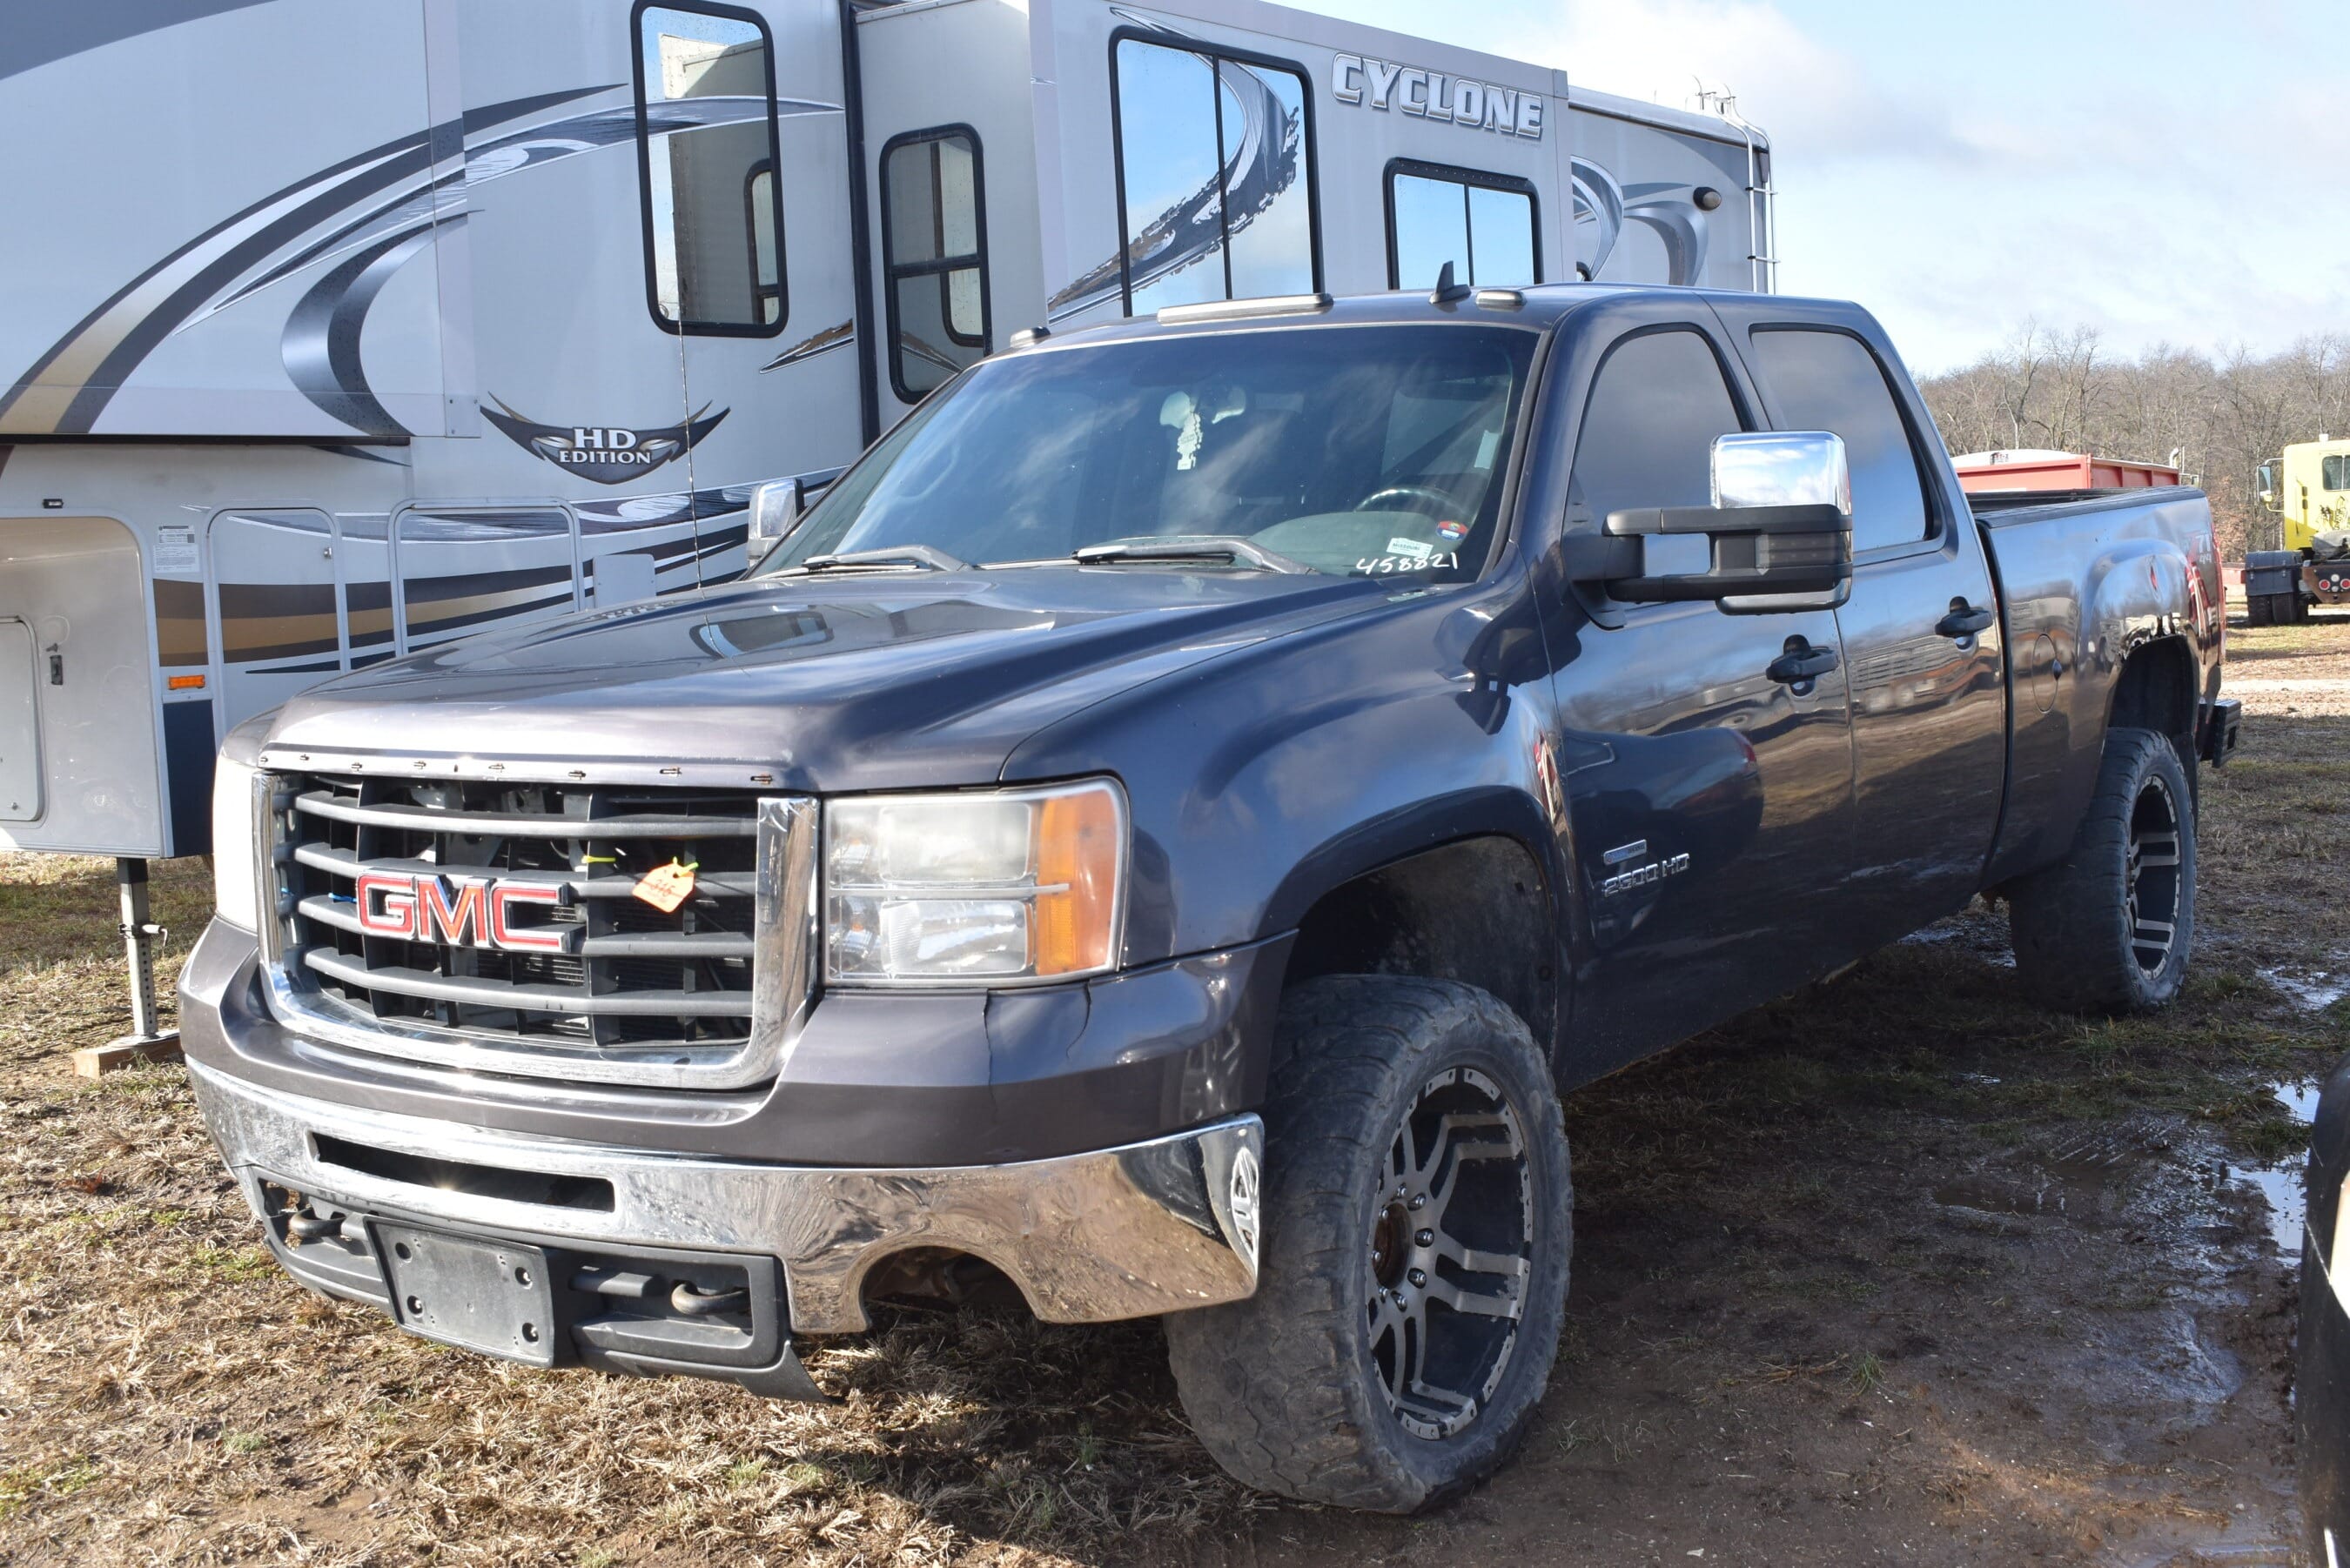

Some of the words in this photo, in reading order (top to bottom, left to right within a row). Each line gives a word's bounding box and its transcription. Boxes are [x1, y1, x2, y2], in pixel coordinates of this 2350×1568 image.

[1332, 52, 1542, 138] CYCLONE
[574, 427, 636, 449] HD
[559, 450, 651, 465] EDITION
[1356, 552, 1459, 574] 458821
[1604, 863, 1659, 898] 2500
[1662, 852, 1690, 878] HD
[357, 868, 571, 953] GMC
